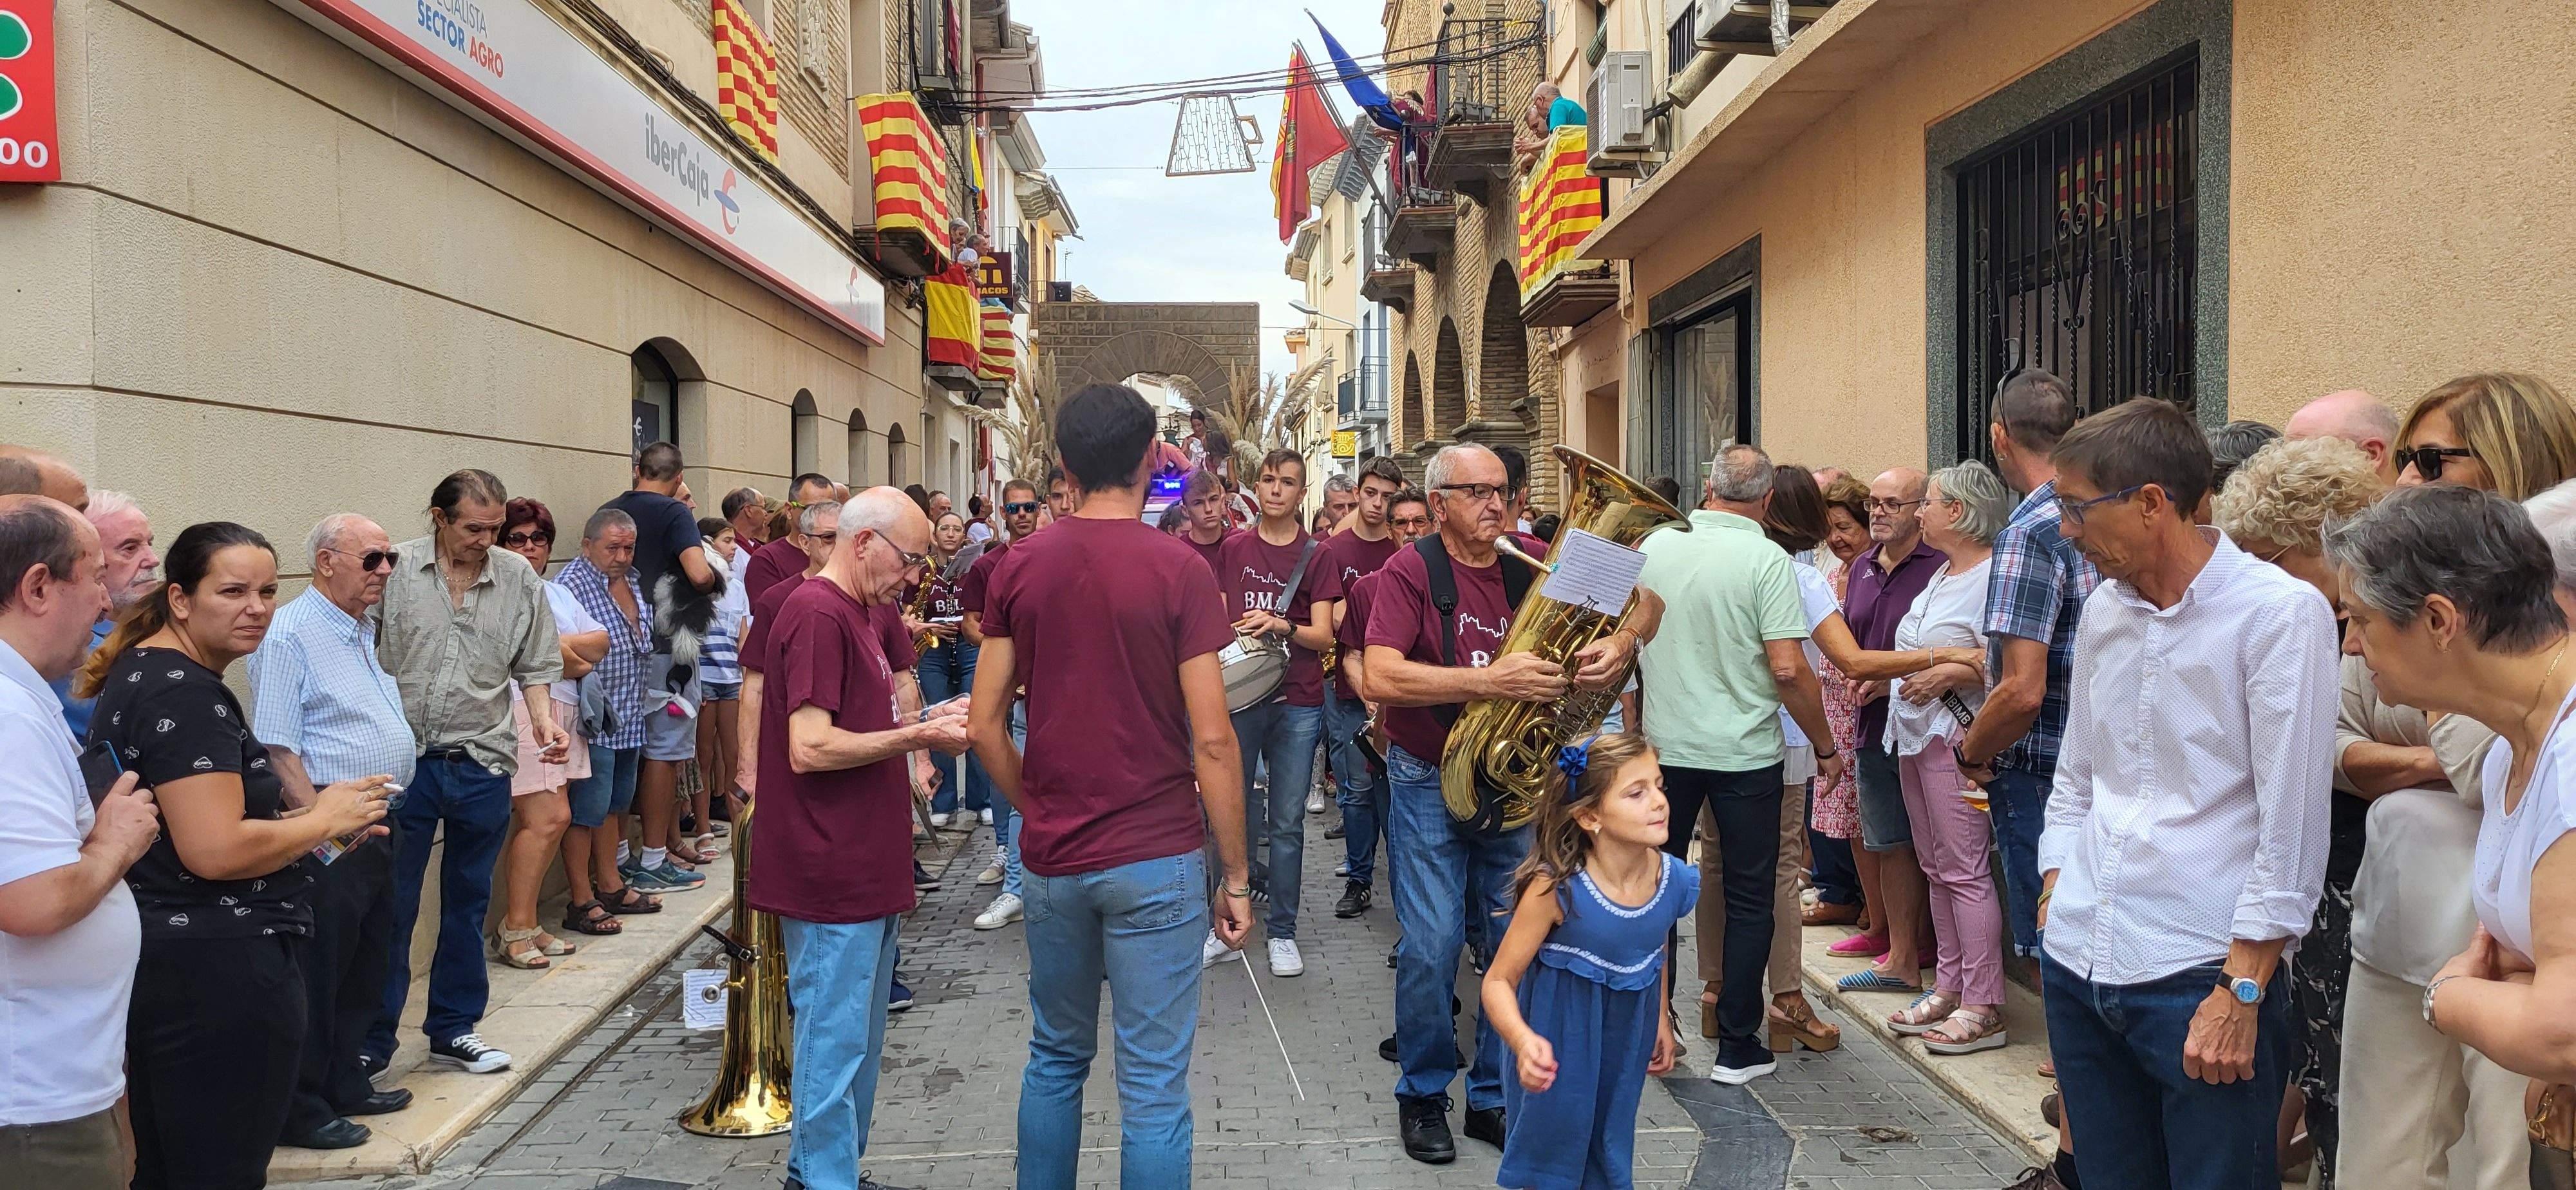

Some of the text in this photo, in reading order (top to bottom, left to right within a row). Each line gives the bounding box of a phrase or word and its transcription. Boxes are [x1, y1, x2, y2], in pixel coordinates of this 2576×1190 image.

[417, 0, 504, 78] SECTOR AGRO
[645, 112, 708, 207] iberCaja
